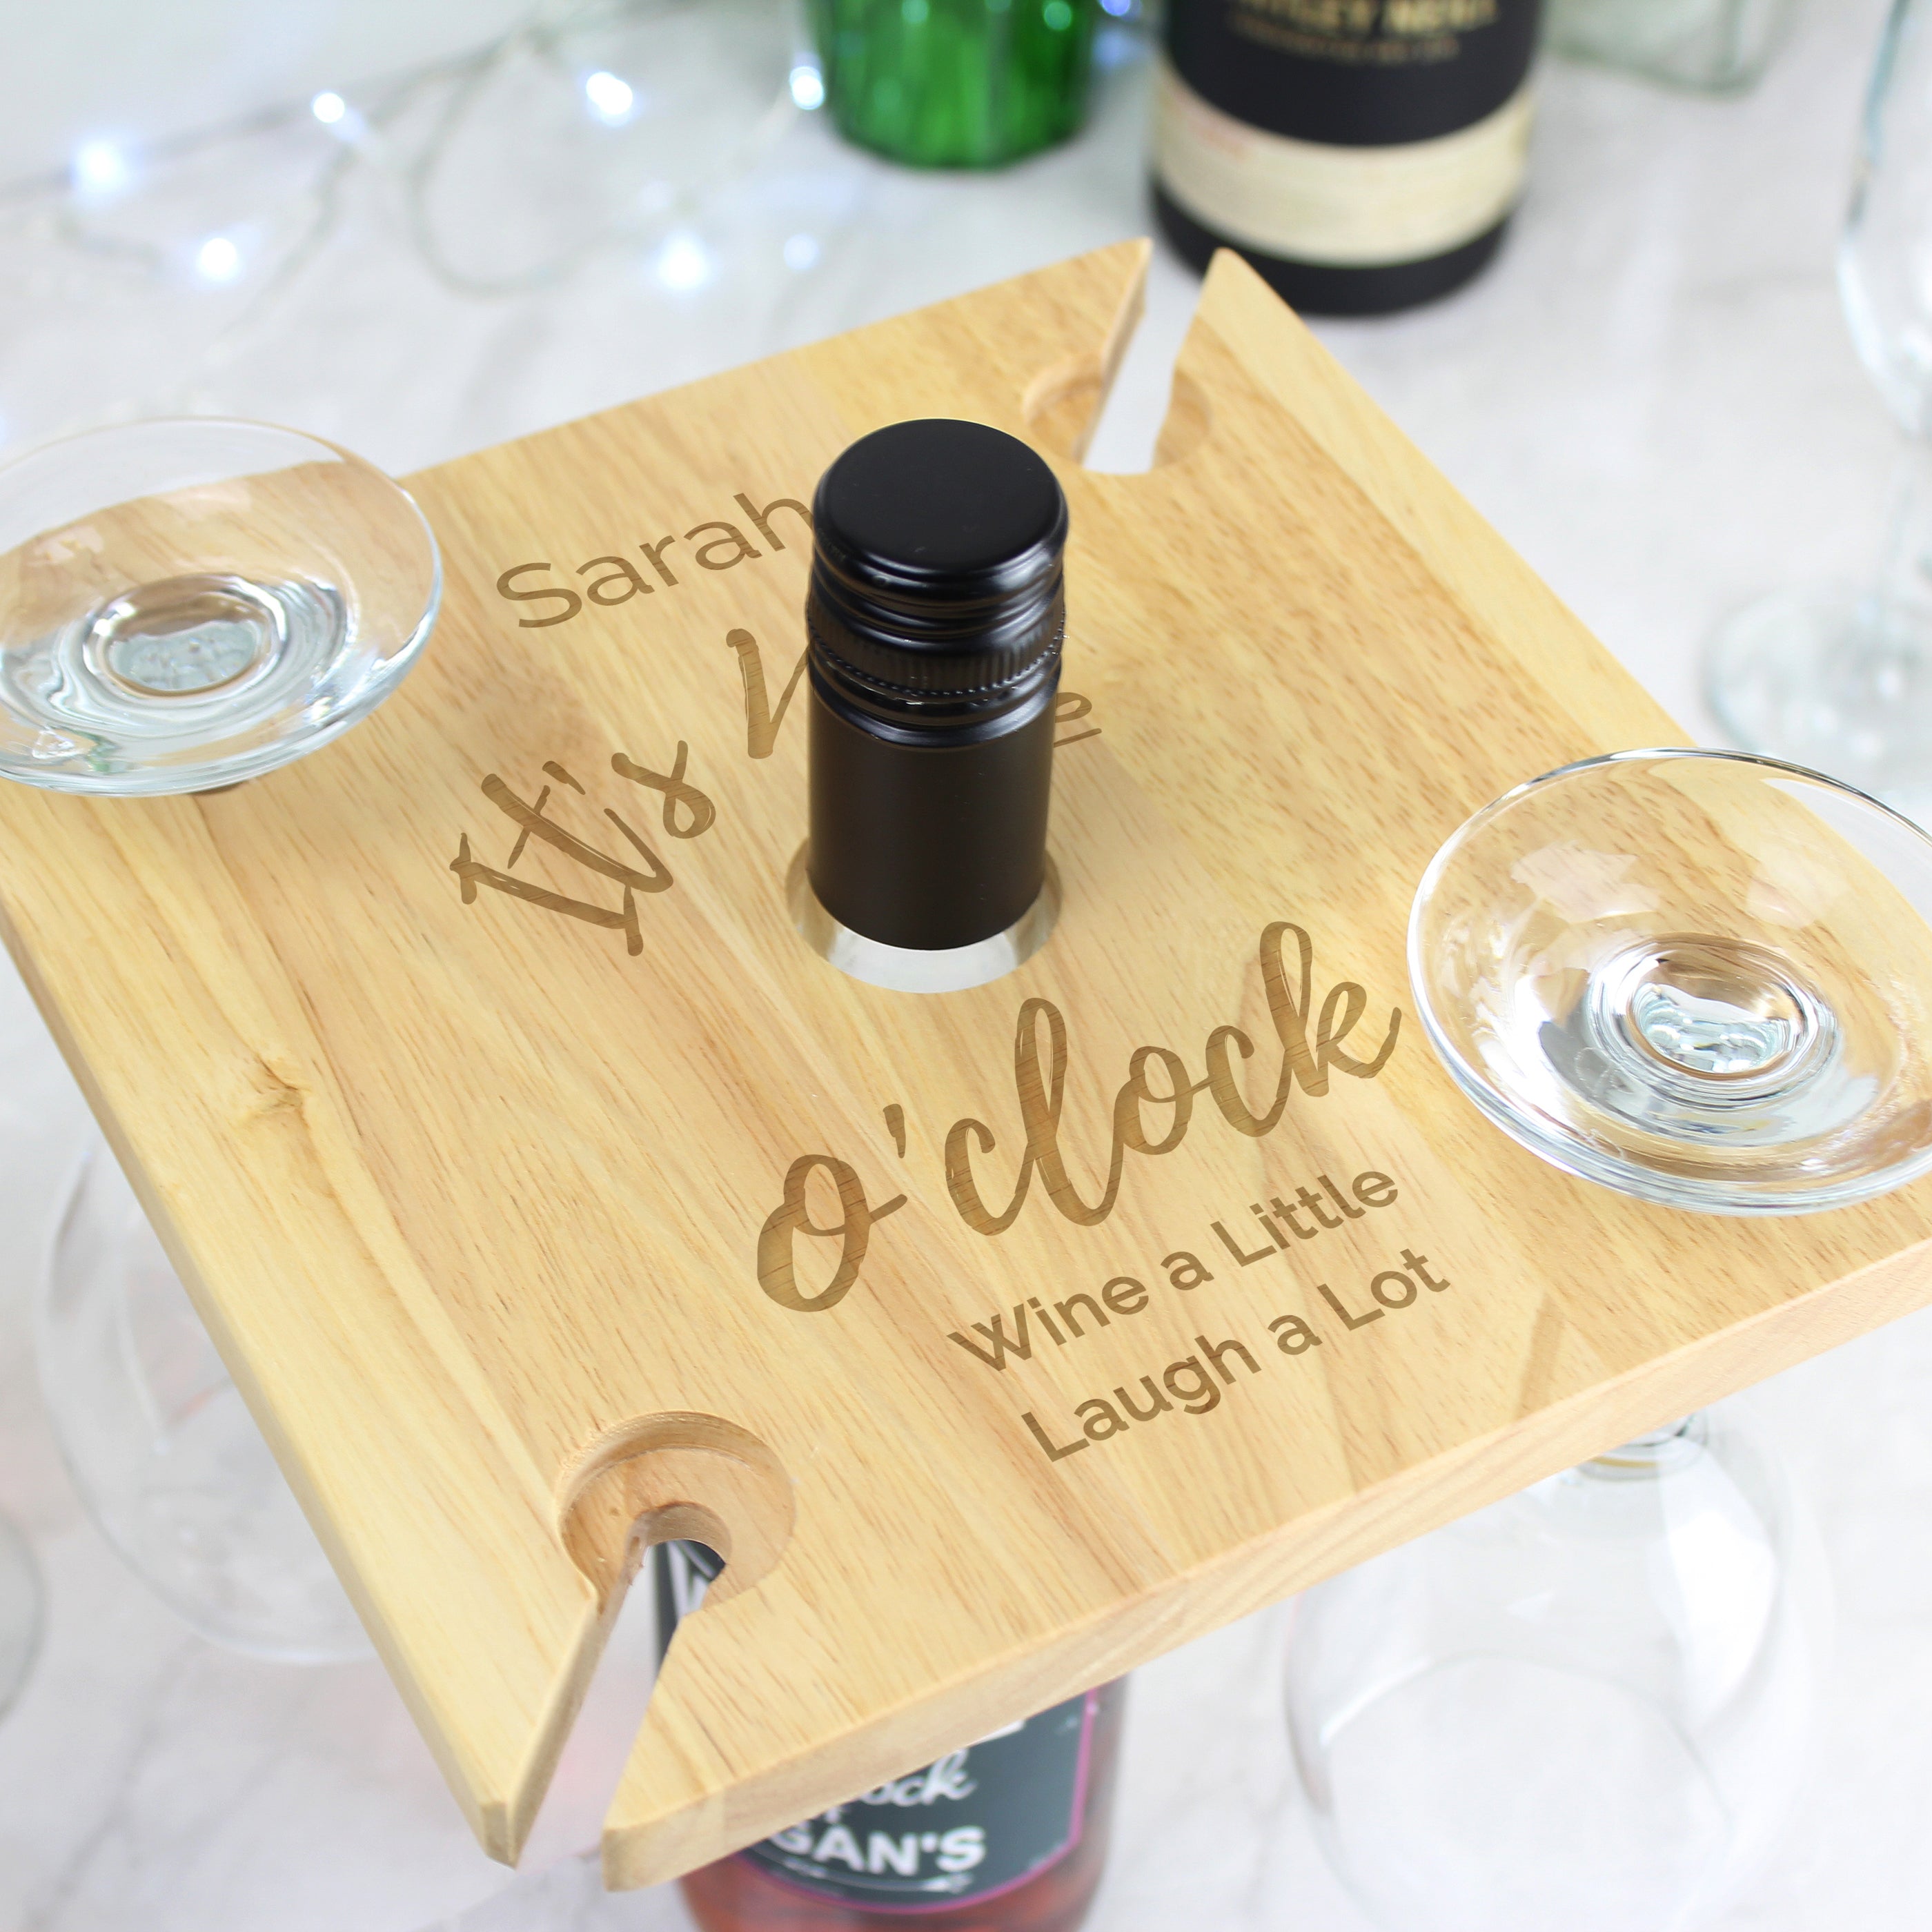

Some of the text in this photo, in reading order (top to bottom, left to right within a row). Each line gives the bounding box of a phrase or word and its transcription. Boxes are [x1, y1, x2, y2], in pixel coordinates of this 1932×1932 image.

[449, 740, 716, 956] It's
[757, 921, 1402, 1312] o'clock
[947, 1170, 1399, 1372] Wine a Little
[1021, 1248, 1450, 1462] Laugh a Lot
